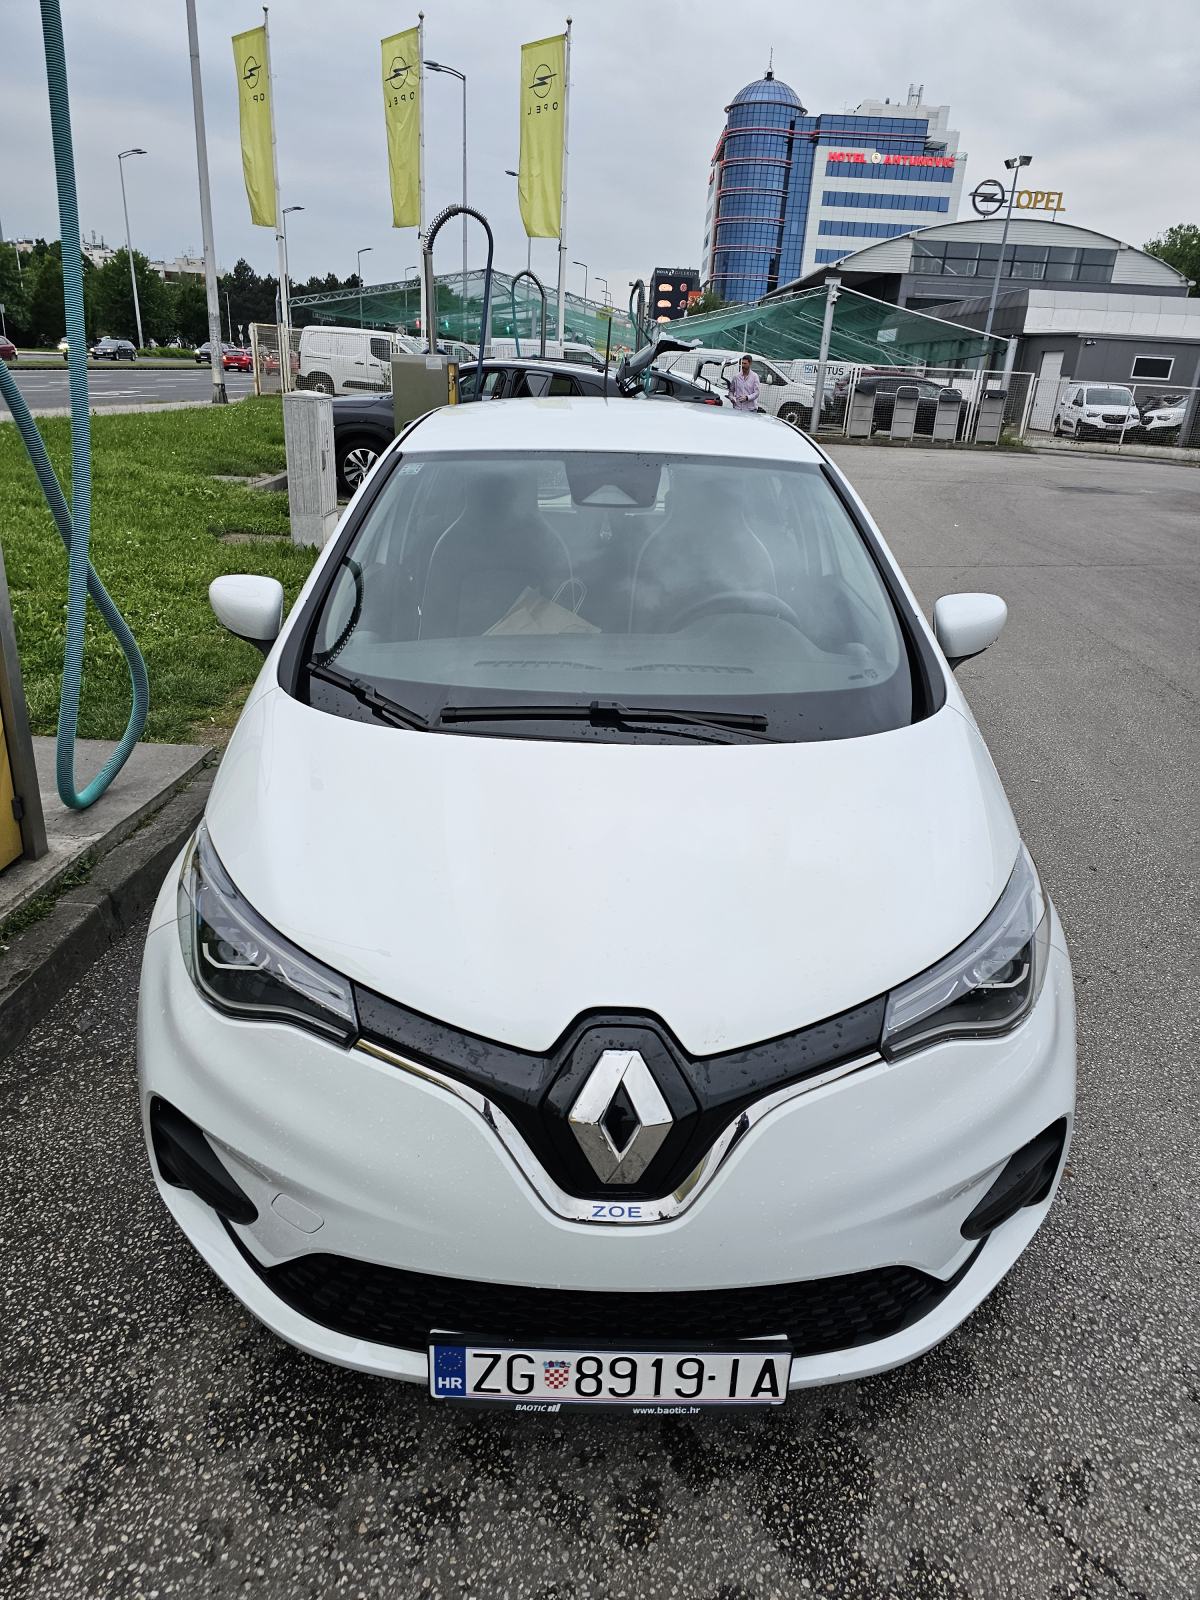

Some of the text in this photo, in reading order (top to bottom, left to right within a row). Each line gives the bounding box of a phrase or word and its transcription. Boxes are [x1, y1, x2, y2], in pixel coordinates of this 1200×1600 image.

[828, 151, 867, 163] HOTEL
[1017, 190, 1066, 211] OPEL
[592, 1206, 642, 1218] ZOE
[473, 1353, 779, 1398] ZG 8919-IA
[438, 1377, 462, 1389] HR
[633, 1406, 700, 1414] www.baotic.hr
